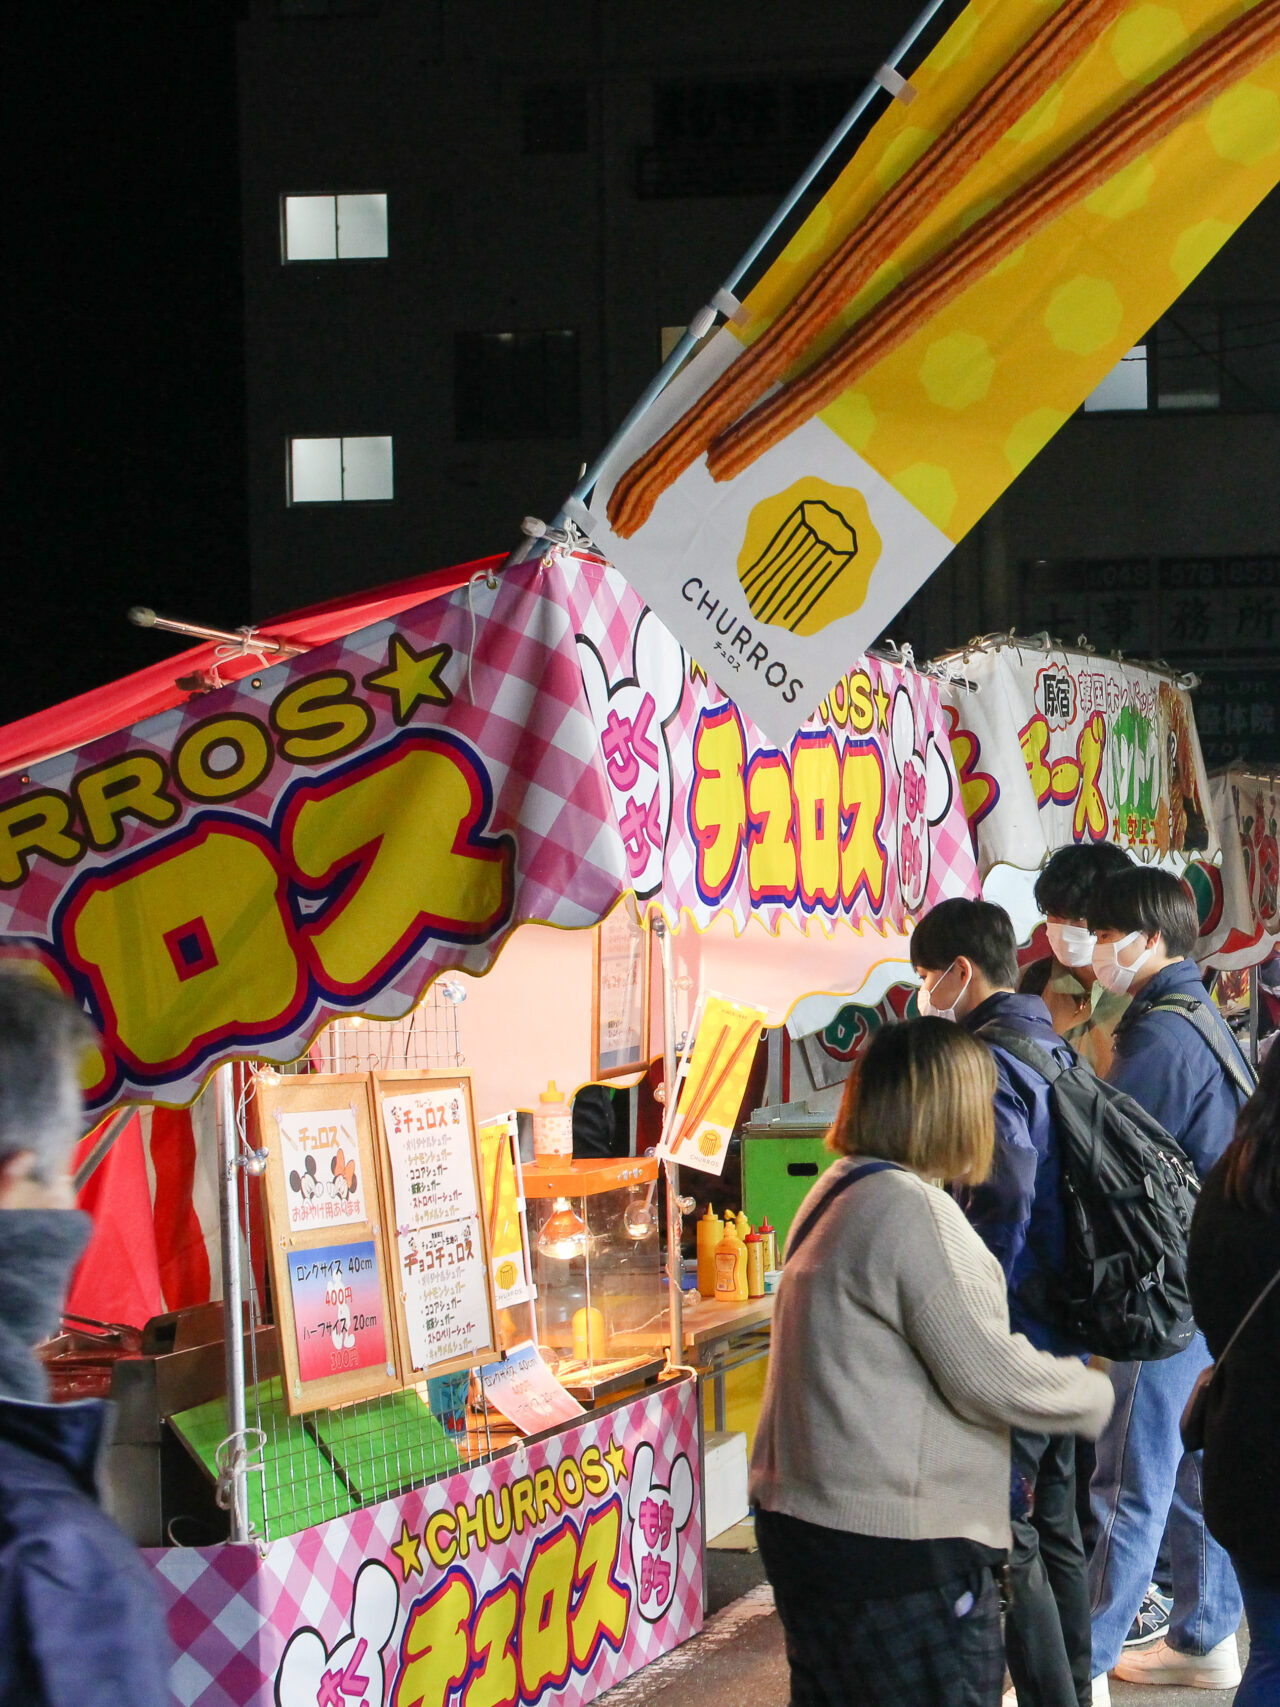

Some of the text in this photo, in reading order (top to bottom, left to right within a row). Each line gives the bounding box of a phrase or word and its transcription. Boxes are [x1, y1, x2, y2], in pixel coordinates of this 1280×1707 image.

[681, 577, 805, 704] CHURROS
[713, 640, 742, 673] チュロス
[1042, 673, 1070, 718] 原宿
[692, 701, 888, 917] チュロス
[403, 1105, 448, 1133] チュロス
[298, 1126, 340, 1151] チュロス
[348, 1257, 373, 1274] 40cm
[403, 1239, 475, 1276] チョコチュロス
[325, 1286, 353, 1306] 400円
[353, 1314, 377, 1332] 20cm
[330, 1347, 360, 1371] 300円
[424, 1446, 609, 1567] CHURROS
[391, 1492, 631, 1707] チュロス
